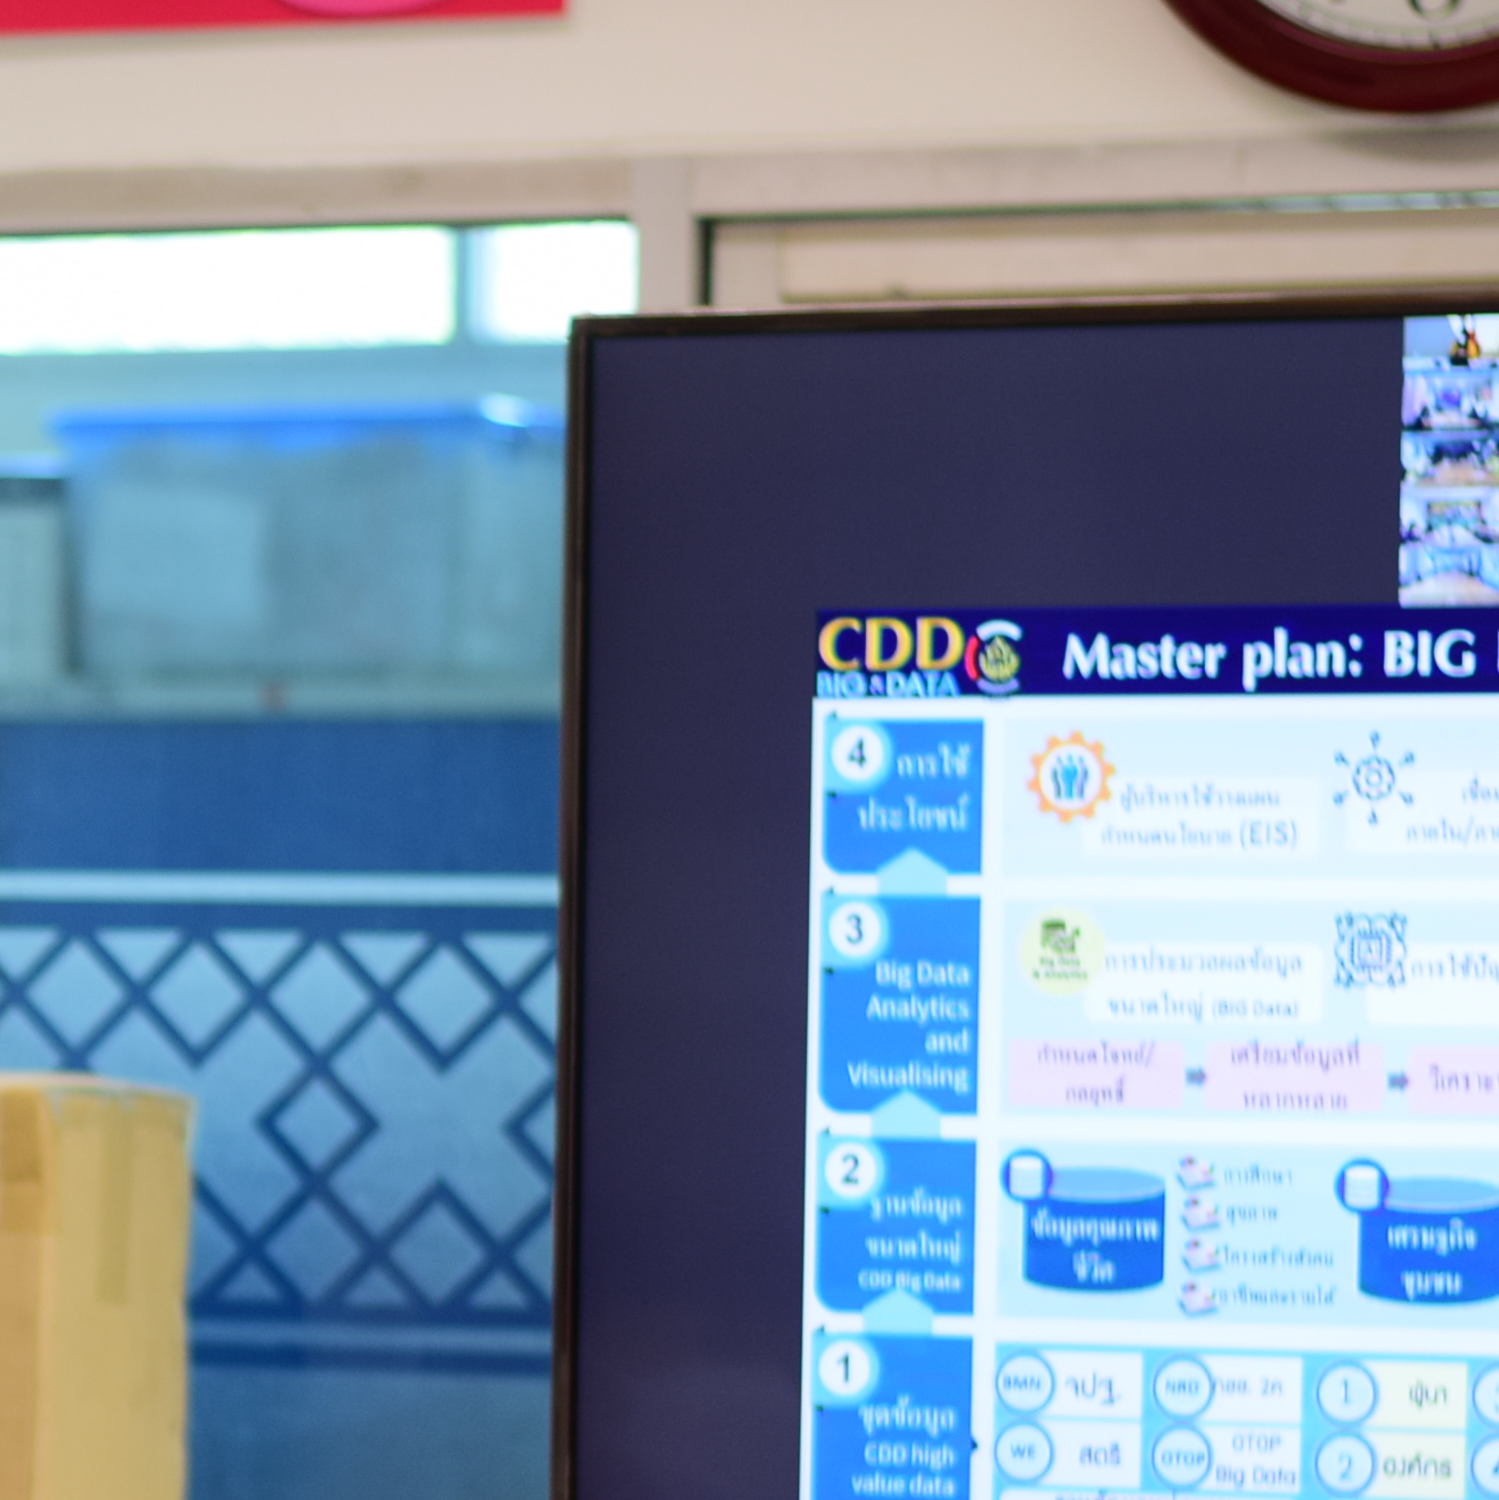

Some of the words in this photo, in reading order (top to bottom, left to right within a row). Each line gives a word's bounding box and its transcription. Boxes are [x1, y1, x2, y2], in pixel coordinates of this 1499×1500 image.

[818, 617, 966, 671] CDD
[1062, 633, 1226, 681] Master
[1241, 626, 1363, 692] plan:
[1382, 628, 1476, 679] BIG
[848, 738, 868, 766] 4
[896, 744, 972, 779] การใช้
[857, 794, 971, 832] ประโยชน์
[1239, 821, 1299, 850] (EIS)
[845, 913, 865, 945] 3
[876, 959, 913, 993] Big
[917, 960, 970, 987] Data
[866, 993, 971, 1028] Analytics
[924, 1026, 969, 1055] and
[847, 1060, 970, 1097] Visualising
[841, 1153, 861, 1186] 2
[858, 1269, 892, 1291] CDD
[895, 1269, 918, 1294] Big
[921, 1270, 962, 1293] Data
[837, 1355, 852, 1382] 1
[1340, 1382, 1352, 1408] 1
[857, 1396, 957, 1438] ชุดข้อมูล
[864, 1441, 904, 1466] CDD
[908, 1441, 955, 1470] high
[1011, 1443, 1037, 1461] WE
[1232, 1433, 1282, 1455] OTOP
[1161, 1449, 1207, 1466] OTOP
[1216, 1464, 1246, 1488] Big
[1253, 1465, 1298, 1487] Data
[1337, 1452, 1353, 1480] 2
[1382, 1448, 1453, 1479] องค์กร
[852, 1472, 901, 1496] value
[907, 1473, 957, 1497] data
